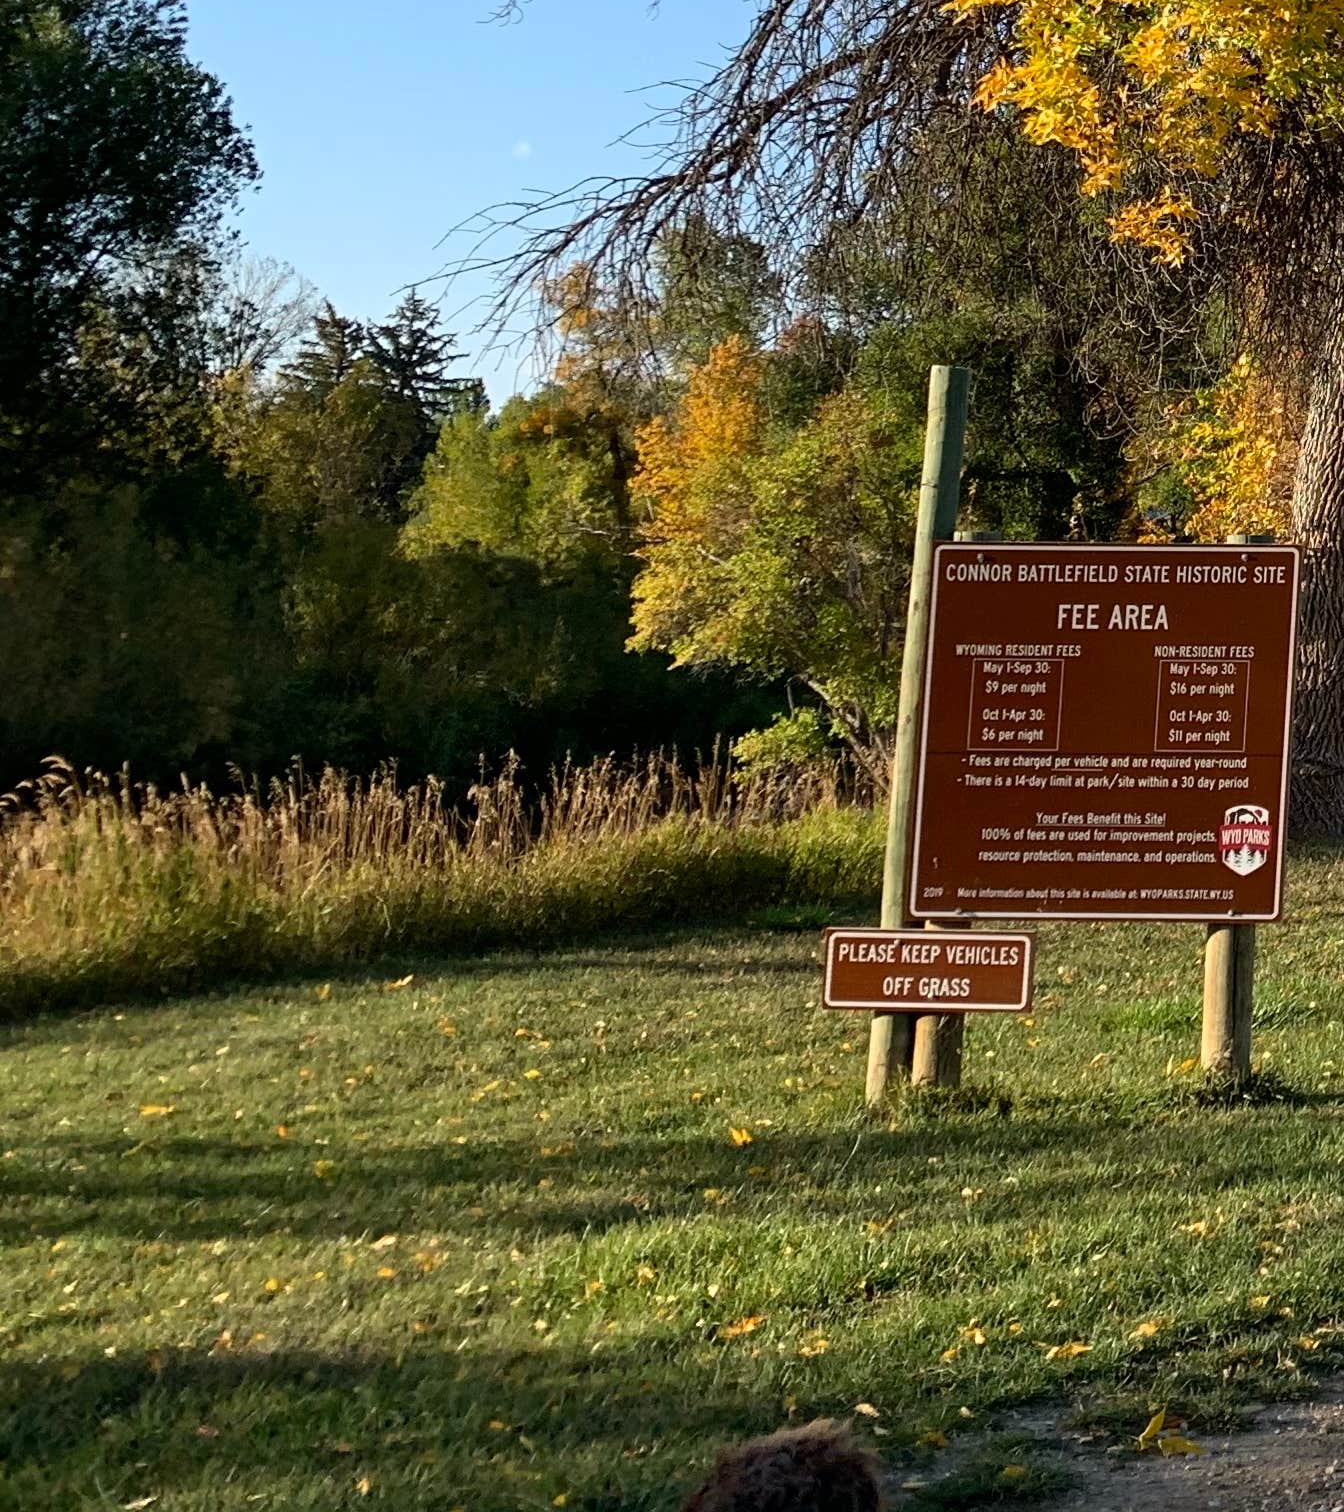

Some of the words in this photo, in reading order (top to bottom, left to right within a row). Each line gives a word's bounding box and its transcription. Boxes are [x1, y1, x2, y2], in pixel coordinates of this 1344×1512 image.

[946, 564, 1012, 582] CONNOR
[1017, 565, 1117, 583] BATTLEFIELD
[1124, 566, 1170, 583] STATE
[1177, 566, 1247, 584] HISTORIC
[1253, 566, 1286, 584] SITE
[1057, 604, 1100, 630] FEE
[1108, 605, 1169, 630] AREA
[955, 645, 1003, 656] WYOMING
[1006, 645, 1054, 657] RESIDENT
[1056, 645, 1081, 657] FEES
[1154, 646, 1228, 658] NON-RESIDENT
[1230, 647, 1255, 658] FEES
[983, 662, 1005, 676] May
[1035, 662, 1051, 674] 30:
[1170, 663, 1190, 677] May
[1220, 663, 1237, 675] 30:
[985, 681, 999, 693] $9
[1001, 683, 1017, 696] per
[1020, 682, 1046, 696] night
[1170, 682, 1187, 695] $16
[1190, 685, 1205, 697] per
[1208, 683, 1235, 697] night
[982, 709, 999, 721] Oct
[1029, 710, 1045, 721] 30:
[1169, 710, 1186, 722] Oct
[1215, 711, 1232, 722] 30:
[982, 728, 995, 741] $6
[999, 732, 1015, 743] per
[1017, 729, 1043, 743] night
[1168, 730, 1182, 743] $11
[1185, 733, 1202, 745] per
[1204, 730, 1230, 744] night
[969, 755, 991, 767] Fees
[994, 757, 1010, 767] are
[1012, 755, 1052, 770] charged
[1054, 758, 1071, 770] per
[1074, 756, 1108, 768] vehicle
[1110, 756, 1129, 768] and
[1132, 758, 1148, 768] are
[1150, 756, 1191, 771] required
[1194, 757, 1247, 771] year-round
[964, 774, 991, 786] There
[994, 775, 1003, 786] is
[1005, 777, 1012, 786] a
[1014, 775, 1047, 790] 14-day
[1050, 775, 1072, 787] limit
[1074, 776, 1085, 787] at
[1137, 776, 1169, 788] within
[1172, 778, 1178, 788] a
[1181, 776, 1194, 788] 30
[1197, 776, 1215, 791] day
[1218, 776, 1248, 791] period
[1036, 812, 1059, 824] Your
[1062, 813, 1084, 825] Fees
[1087, 813, 1121, 825] Benefit
[1124, 813, 1142, 825] this
[1144, 813, 1166, 825] Site!
[981, 829, 1011, 840] 100%
[1014, 829, 1024, 841] of
[1026, 829, 1046, 841] fees
[1049, 831, 1065, 841] are
[1068, 830, 1091, 841] used
[1093, 830, 1107, 842] for
[1109, 830, 1174, 844] improvement
[1221, 829, 1242, 845] WYO
[1243, 829, 1270, 845] PARKS
[978, 852, 1020, 861] resource
[1144, 851, 1162, 863] and
[1165, 851, 1217, 865] operations.
[923, 888, 943, 898] 2019
[957, 888, 977, 898] More
[978, 888, 1024, 898] information
[1025, 888, 1048, 899] about
[1050, 888, 1064, 899] this
[1066, 888, 1081, 899] site
[1082, 889, 1089, 899] is
[1091, 889, 1127, 899] available
[838, 943, 896, 963] PLEASE
[901, 944, 941, 964] KEEP
[946, 945, 1019, 965] VEHICLES
[882, 976, 913, 996] OFF
[919, 978, 970, 997] GRASS
